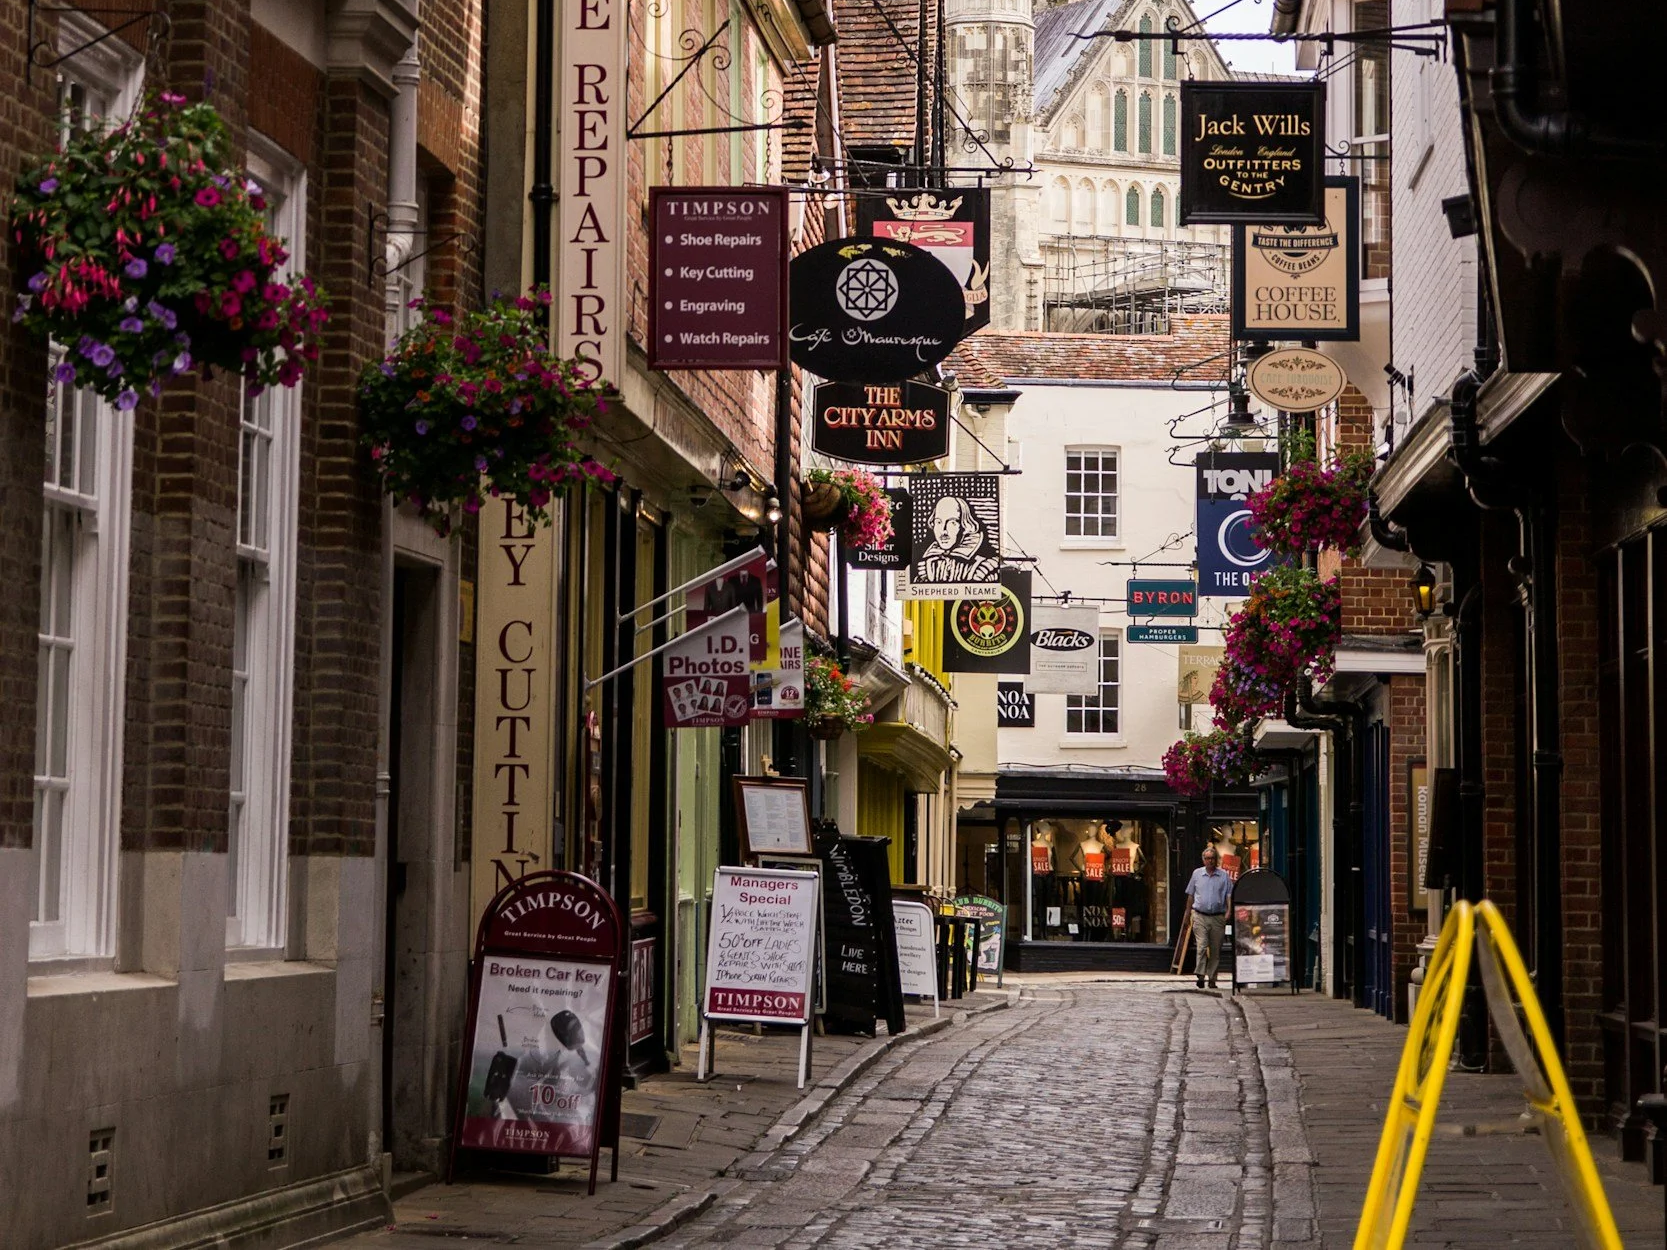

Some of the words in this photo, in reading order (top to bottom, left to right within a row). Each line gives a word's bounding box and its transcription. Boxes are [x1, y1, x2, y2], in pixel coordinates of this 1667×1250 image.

[1194, 113, 1246, 142] Jack
[1252, 113, 1311, 136] Wills
[1208, 144, 1244, 156] London
[1257, 145, 1297, 159] England
[1203, 157, 1302, 171] OUTFITTERS
[1236, 171, 1249, 179] TO
[1251, 171, 1269, 179] THE
[1219, 175, 1285, 194] GENTRY
[666, 201, 770, 216] TIMPSON
[569, 63, 611, 387] REPAIRS
[679, 233, 713, 246] Shoe
[714, 233, 762, 249] Repairs
[1257, 236, 1278, 247] TASTE
[1278, 237, 1292, 248] THE
[1292, 237, 1334, 248] DIFFERENCE
[1270, 254, 1297, 271] COFFEE
[1298, 255, 1321, 271] BEANS
[679, 266, 705, 281] Key
[706, 266, 754, 281] Cutting
[1255, 286, 1337, 302] COFFEE
[679, 299, 745, 314] Engraving
[1255, 303, 1337, 321] HOUSE
[679, 332, 720, 345] Watch
[722, 332, 770, 348] Repairs
[841, 326, 943, 363] Mauresque
[863, 385, 902, 407] THE
[823, 406, 876, 430] CITY
[875, 407, 937, 430] ARMS
[865, 429, 903, 450] INN
[1203, 469, 1274, 494] TONI
[500, 497, 537, 587] EY
[864, 538, 895, 551] Siler
[858, 551, 900, 564] Designs
[1213, 571, 1239, 587] THE
[911, 586, 959, 596] SHEPHERD
[964, 585, 997, 596] NEAME
[1133, 591, 1193, 605] BYRON
[706, 635, 744, 654] I.D.
[968, 633, 1007, 647] BURRITO
[1035, 629, 1090, 648] Blacks
[668, 655, 745, 675] Photos
[1183, 654, 1225, 668] TERRAC
[997, 690, 1030, 705] NOA
[997, 705, 1030, 719] NOA
[691, 716, 725, 724] TIMPSON
[490, 620, 537, 897] CUTTIN
[1134, 783, 1147, 792] 28
[1033, 862, 1049, 872] SALE
[1085, 868, 1103, 878] SALE
[1112, 863, 1130, 873] SALE
[730, 875, 799, 891] Managers
[829, 843, 867, 927] WIMBLEDON
[739, 892, 791, 906] Special
[953, 897, 970, 906] LUB
[973, 896, 1003, 913] BURRITO
[500, 891, 606, 931] TIMPSON
[1083, 905, 1109, 916] NOA
[1083, 916, 1109, 928] NOA
[575, 935, 597, 943] People
[743, 937, 764, 948] OFF
[764, 936, 802, 954] LADIES
[841, 944, 865, 960] LIVE
[717, 959, 758, 970] REPAIRS
[842, 960, 869, 975] HERE
[489, 962, 541, 978] Broken
[545, 966, 571, 982] Car
[575, 968, 602, 986] Key
[507, 984, 531, 993] Need
[532, 986, 539, 994] it
[540, 987, 583, 999] repairing?
[714, 992, 800, 1010] TIMPSON
[557, 1095, 581, 1110] off
[505, 1128, 550, 1138] TIMPSON
